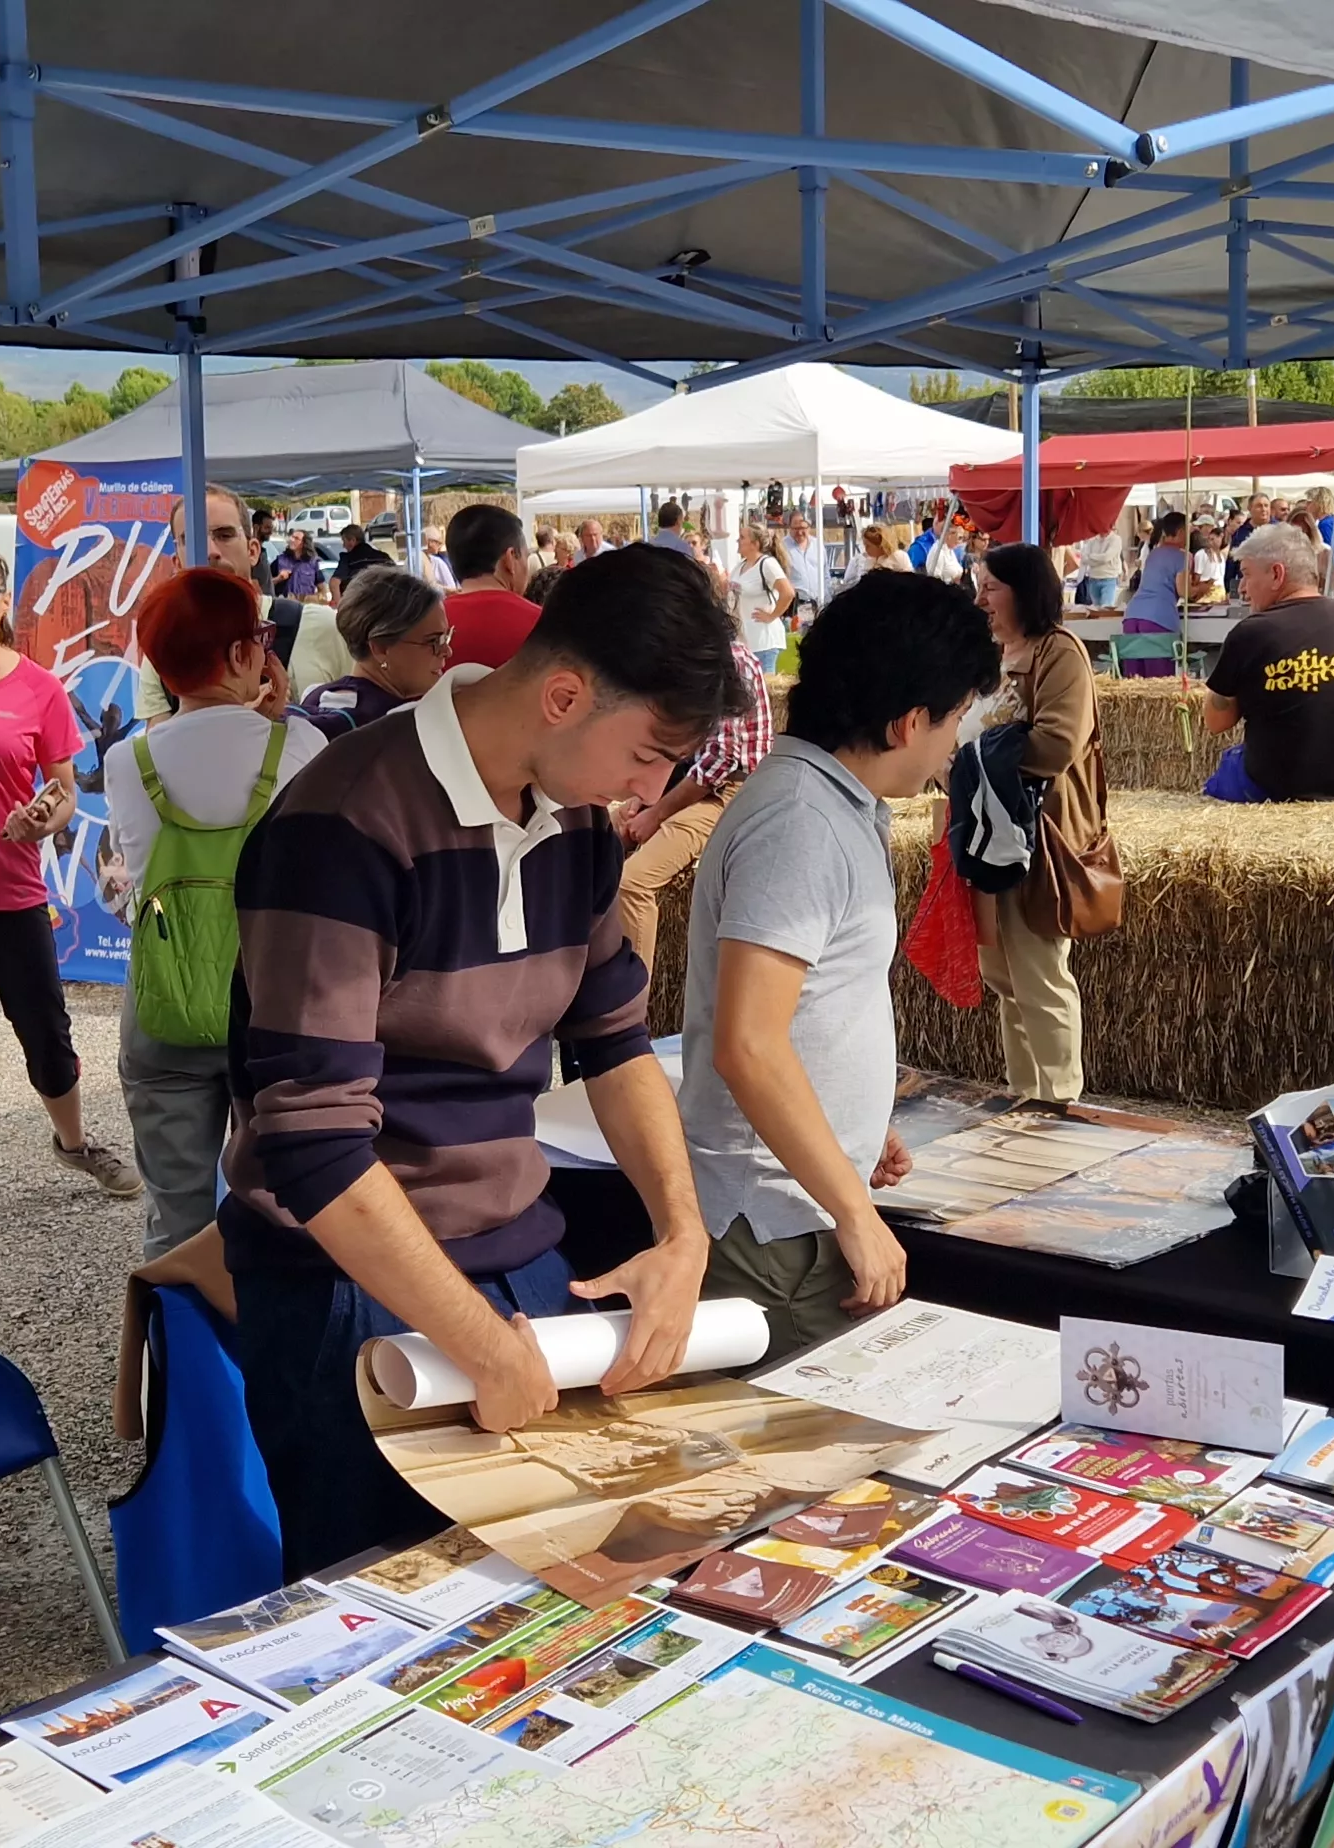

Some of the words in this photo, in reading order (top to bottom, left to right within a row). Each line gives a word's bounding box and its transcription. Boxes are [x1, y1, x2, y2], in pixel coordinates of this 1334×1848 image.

[128, 483, 139, 492] de
[97, 935, 113, 947] Tel.
[861, 1311, 943, 1355] CLANDESTINO
[1167, 1368, 1177, 1407] puertas
[1174, 1357, 1188, 1419] abiertas
[420, 1580, 466, 1604] ARAGÓN
[217, 1640, 275, 1664] ARAGÓN
[274, 1631, 302, 1647] BIKE
[238, 1728, 294, 1763] Senderos
[292, 1687, 369, 1734] recomendados
[801, 1681, 843, 1702] Reino
[843, 1697, 863, 1710] de
[864, 1704, 885, 1719] los
[887, 1713, 936, 1737] Mallos
[71, 1732, 132, 1759] ARAGÓN
